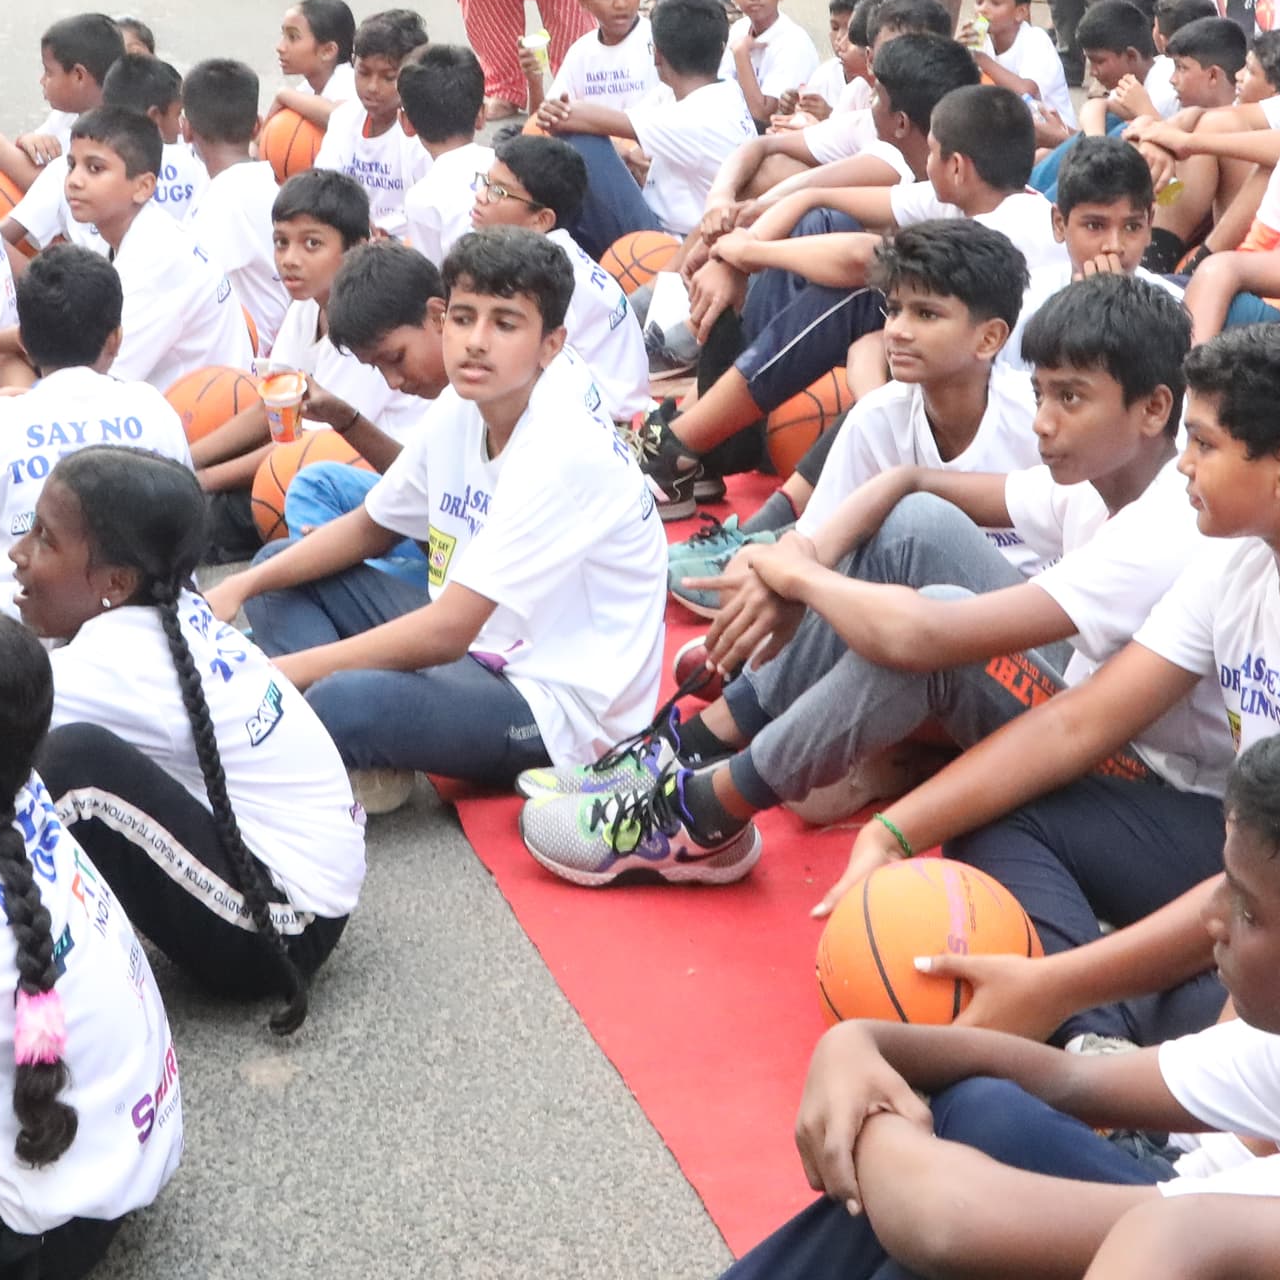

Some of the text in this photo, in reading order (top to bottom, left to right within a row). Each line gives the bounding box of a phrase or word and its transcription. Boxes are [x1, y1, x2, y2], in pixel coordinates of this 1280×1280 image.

[27, 416, 143, 449] SAY NO
[7, 455, 50, 484] TO
